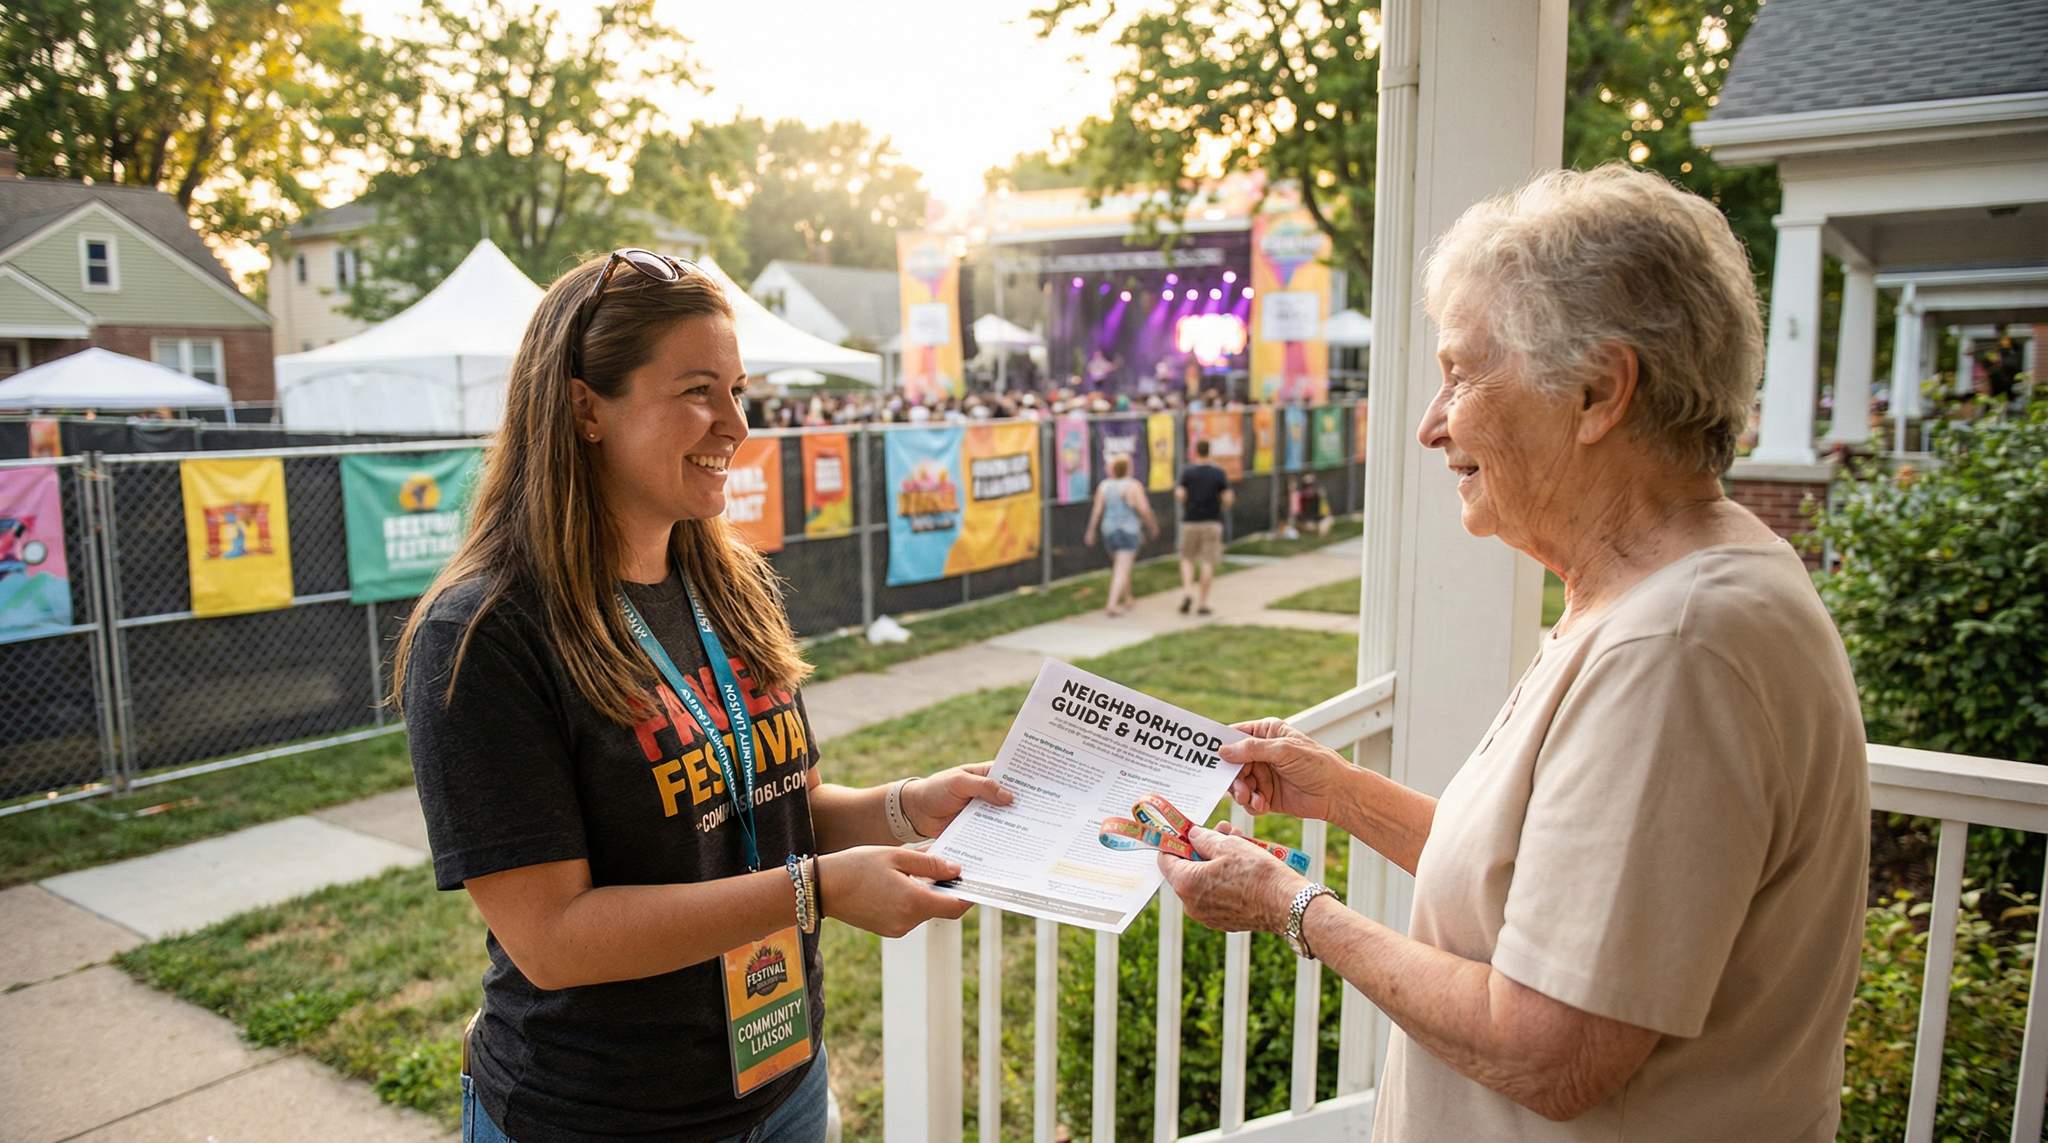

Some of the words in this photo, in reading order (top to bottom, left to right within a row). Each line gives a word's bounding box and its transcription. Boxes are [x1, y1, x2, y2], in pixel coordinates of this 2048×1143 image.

[724, 684, 747, 731] LIAISON
[1061, 679, 1223, 753] NEIGHBORHOOD
[1051, 696, 1115, 731] GUIDE
[1115, 721, 1130, 738] &
[1133, 729, 1221, 770] HOTLINE
[652, 709, 809, 818] FESTIVA
[746, 962, 786, 988] FESTIVAL
[737, 998, 802, 1044] COMMUNITY
[751, 1025, 793, 1056] LIAISON
